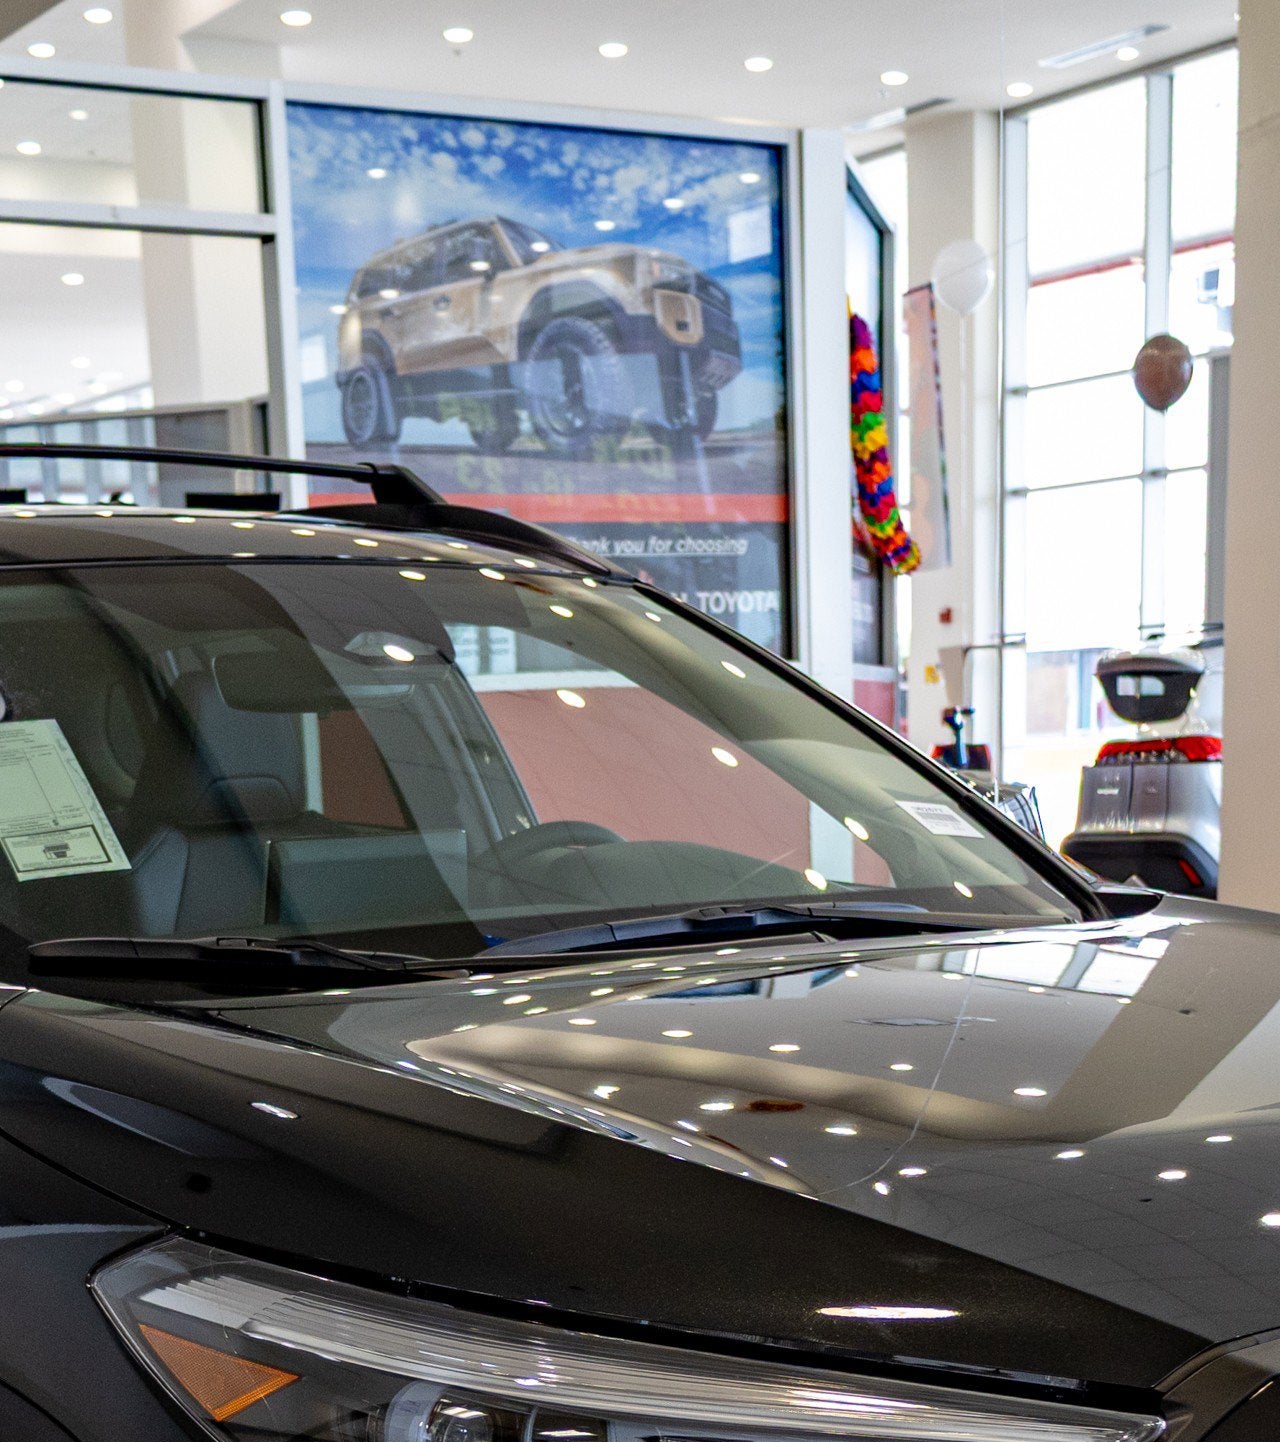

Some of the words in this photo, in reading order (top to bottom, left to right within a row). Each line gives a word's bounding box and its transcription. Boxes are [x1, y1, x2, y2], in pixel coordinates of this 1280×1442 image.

[613, 539, 645, 555] you
[646, 535, 673, 553] for
[675, 536, 749, 556] choosing
[696, 589, 780, 614] TOYOTA
